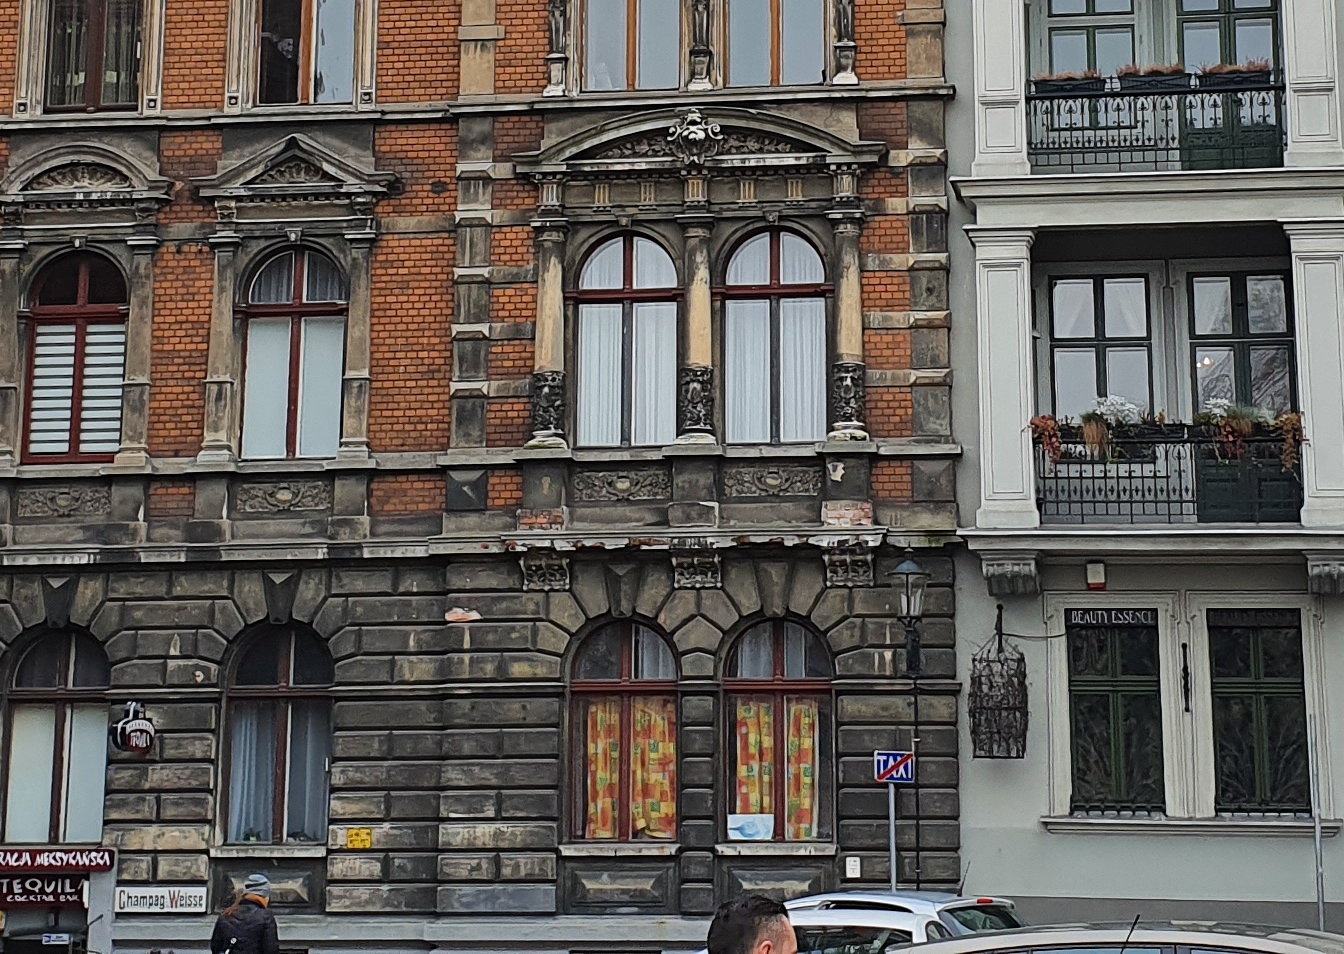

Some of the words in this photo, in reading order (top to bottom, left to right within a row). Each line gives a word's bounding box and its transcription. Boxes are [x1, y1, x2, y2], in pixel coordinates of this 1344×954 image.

[1071, 610, 1107, 624] BEAUTY
[1111, 610, 1155, 624] ESSENCE
[876, 755, 912, 779] TAXI
[168, 889, 204, 909] Weisse
